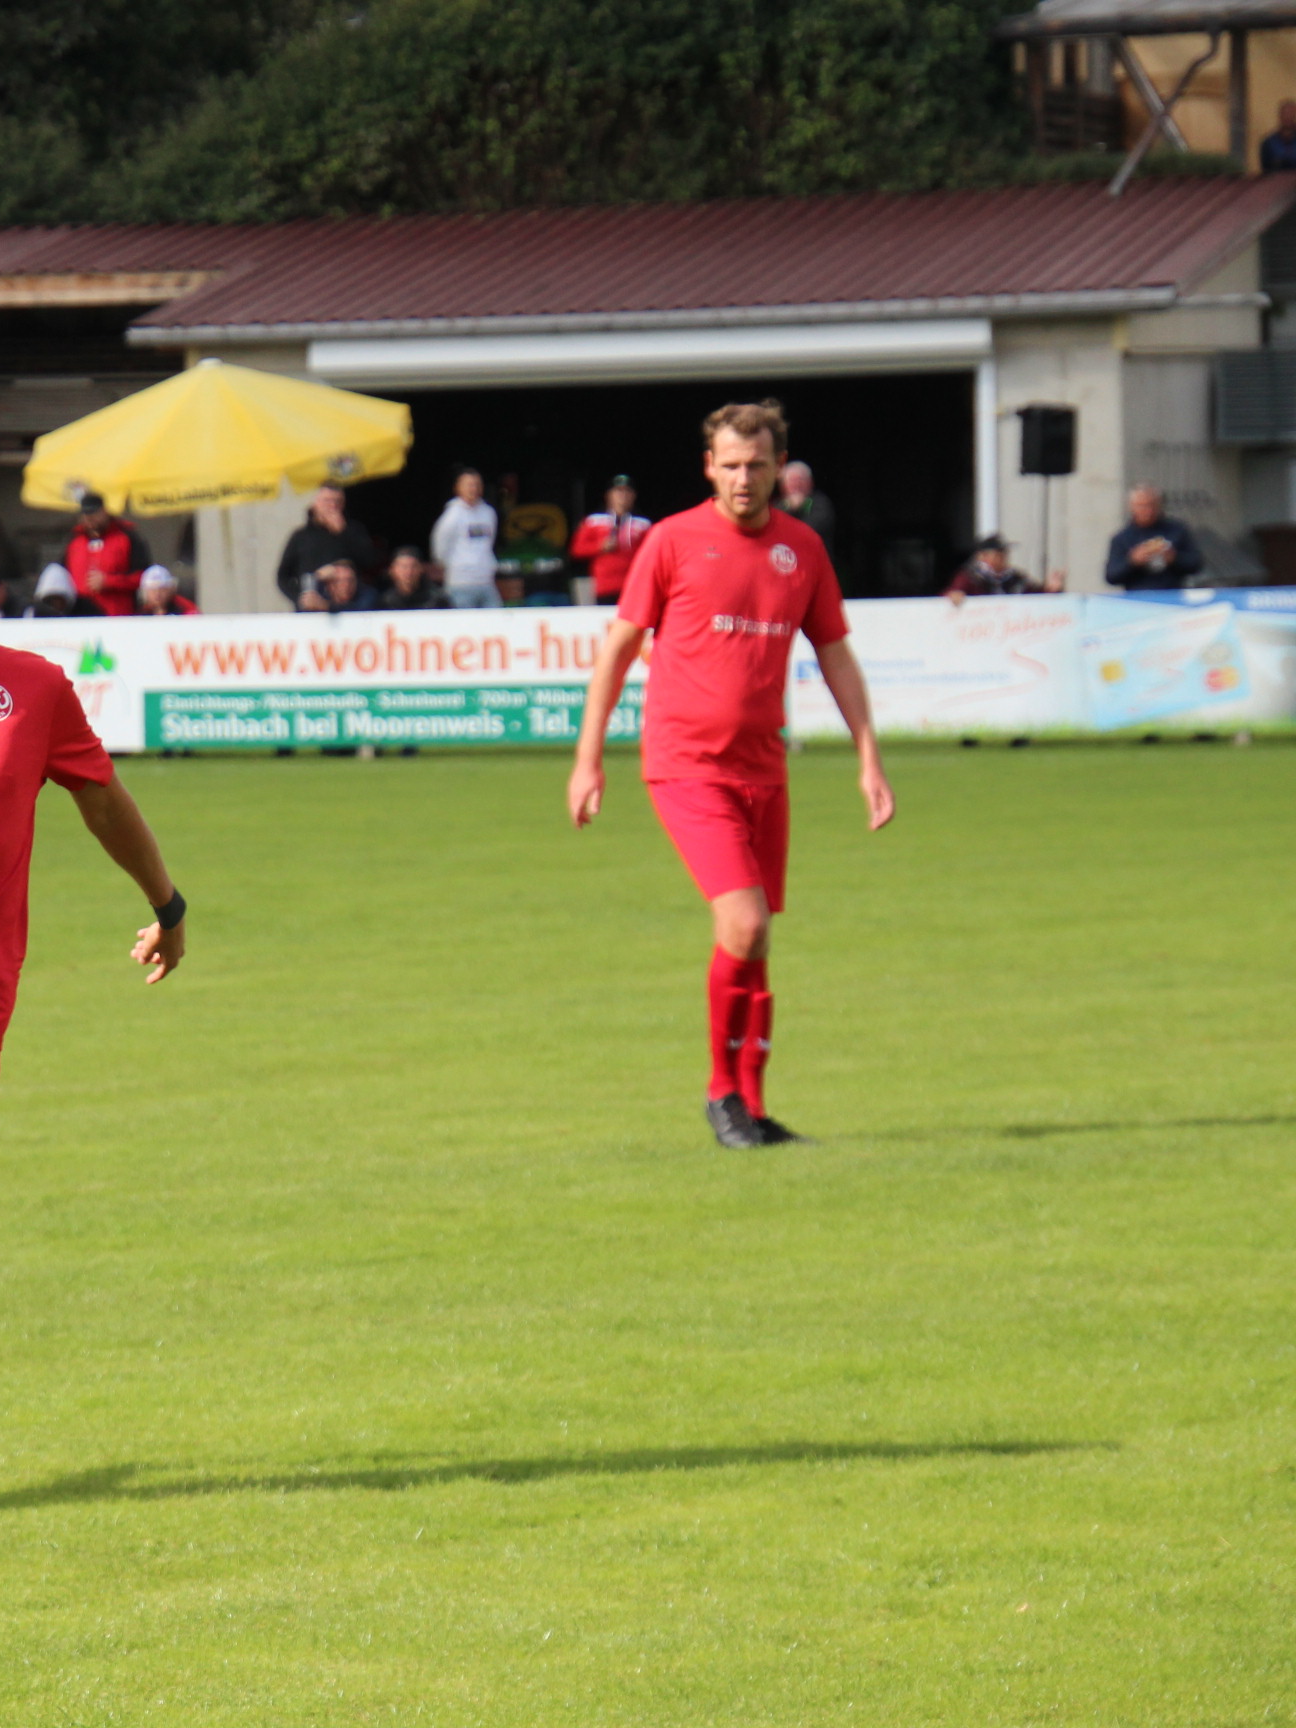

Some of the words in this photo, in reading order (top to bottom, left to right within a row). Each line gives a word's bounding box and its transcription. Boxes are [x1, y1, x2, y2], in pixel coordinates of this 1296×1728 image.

[713, 614, 733, 631] SR
[161, 713, 290, 741] Steinbach
[294, 713, 338, 739] bei
[343, 711, 505, 738] Moorenweis
[528, 707, 578, 735] Tel.
